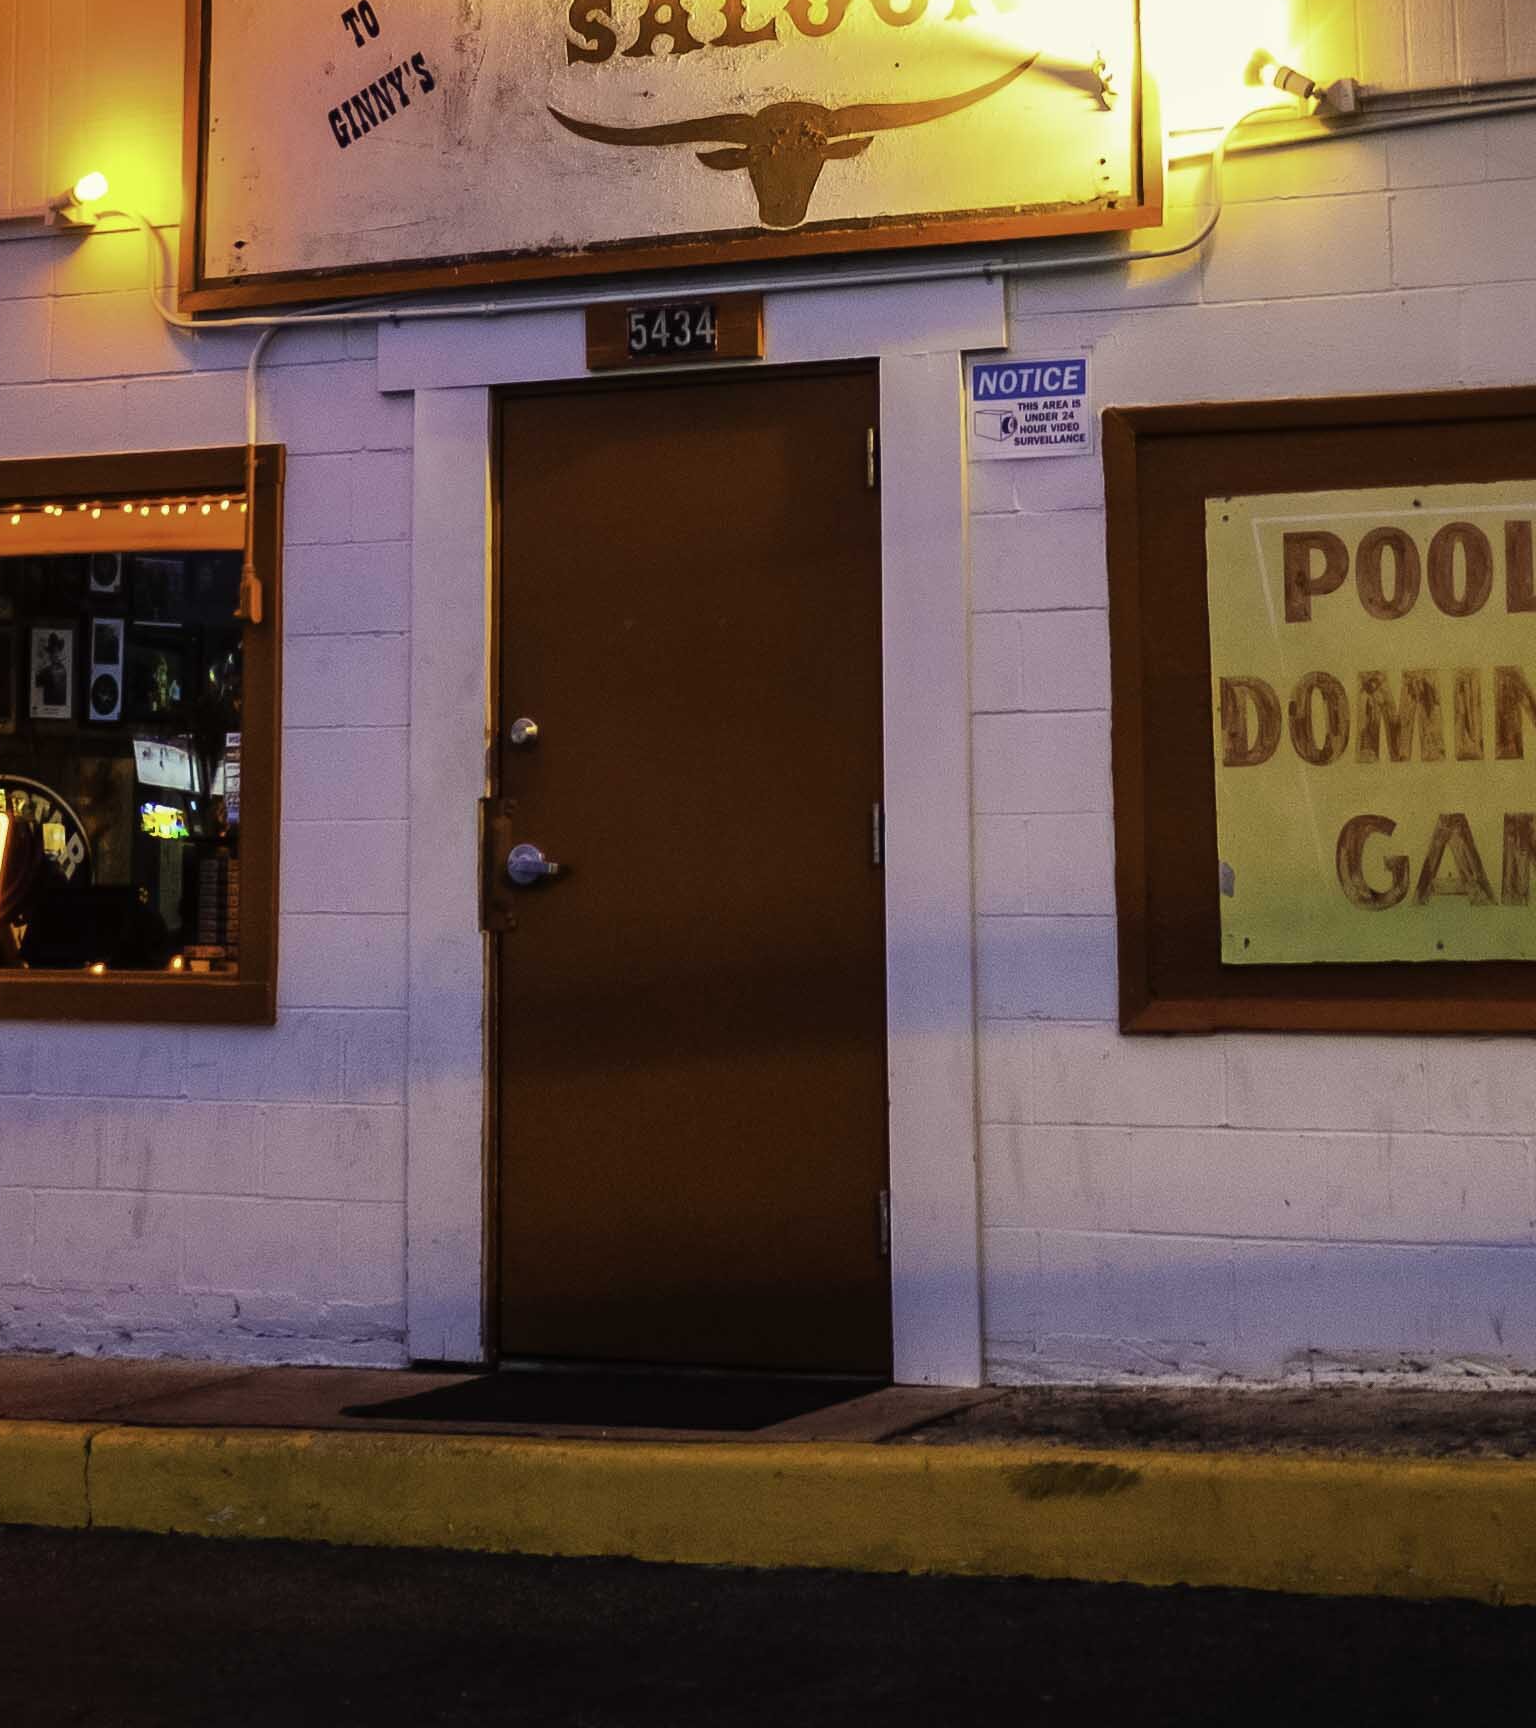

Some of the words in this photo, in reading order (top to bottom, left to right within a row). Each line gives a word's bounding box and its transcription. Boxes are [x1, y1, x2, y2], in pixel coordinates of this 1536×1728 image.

[341, 0, 380, 48] TO
[328, 52, 435, 149] GINNY'S
[630, 305, 714, 350] 5434
[978, 365, 1080, 395] NOTICE
[1017, 402, 1038, 411] THIS
[1042, 400, 1068, 410] AREA
[1072, 399, 1081, 408] IS
[1025, 412, 1057, 422] UNDER
[1062, 411, 1074, 420] 24
[1020, 424, 1047, 434] HOUR
[1051, 422, 1080, 432] VIDEO
[1014, 433, 1085, 446] SURVEILLANCE
